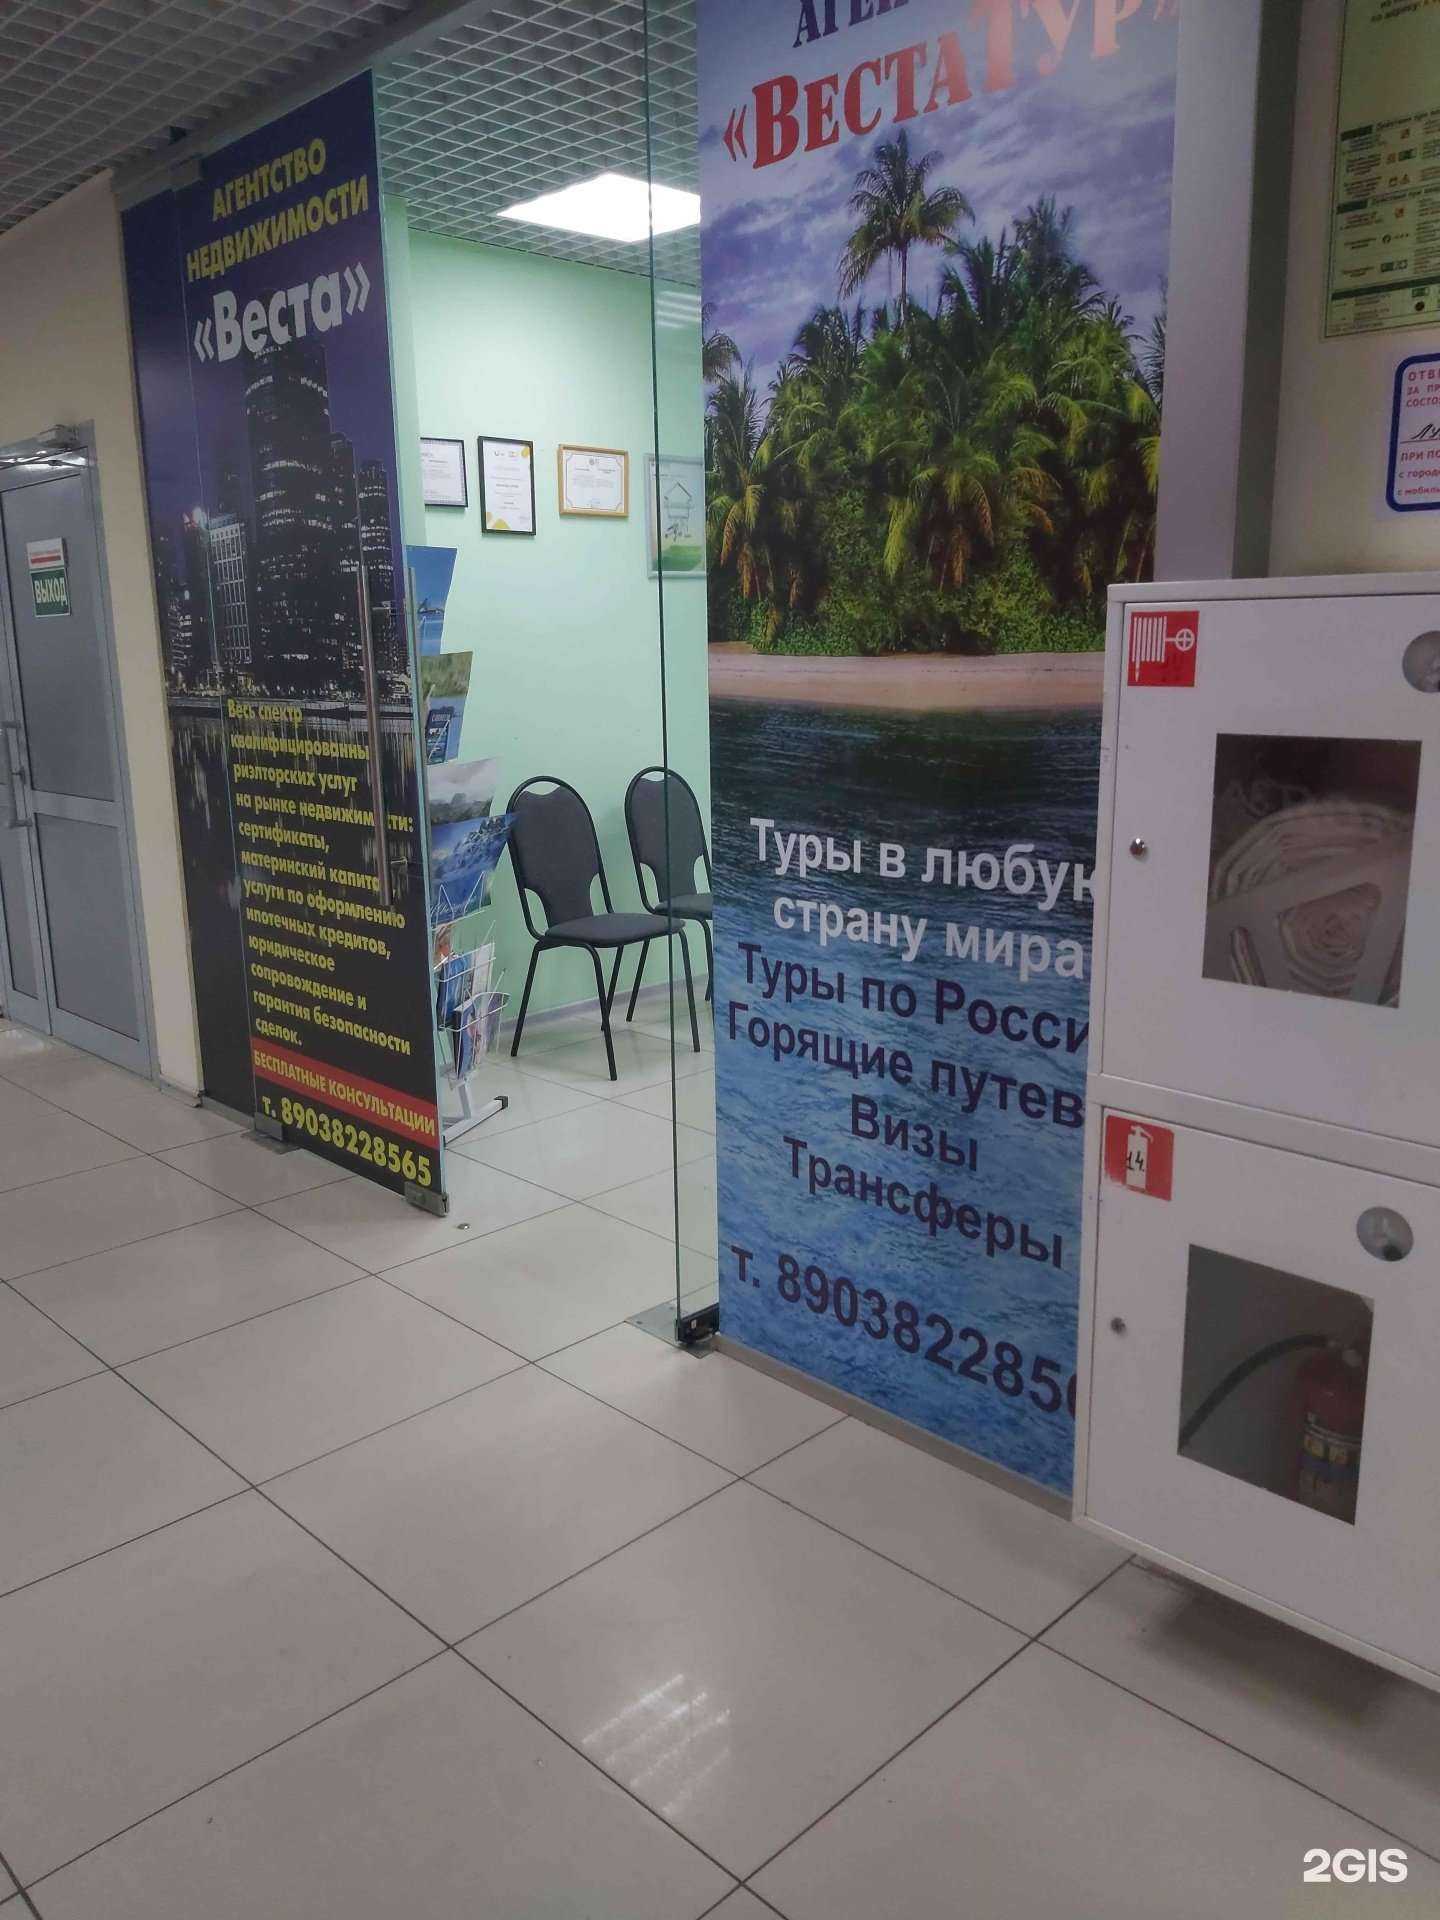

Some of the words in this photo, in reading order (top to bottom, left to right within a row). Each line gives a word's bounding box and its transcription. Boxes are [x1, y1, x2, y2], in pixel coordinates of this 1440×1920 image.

[212, 138, 326, 221] АГЕНТСТВО
[187, 174, 368, 282] НЕДВИЖИМОСТИ
[194, 262, 371, 363] «Веста»
[1408, 368, 1440, 382] ОТВ
[1406, 396, 1440, 408] СОСТО
[1401, 451, 1424, 462] ПРИ
[34, 577, 68, 607] ВЫХОД
[227, 699, 255, 718] Весь
[258, 704, 303, 729] спектр
[230, 731, 370, 761] квалифицированны
[233, 762, 316, 788] риэлторских
[318, 772, 358, 797] услуг
[236, 792, 252, 809] на
[255, 794, 297, 816] рынке
[299, 802, 415, 833] недвижимти:
[238, 821, 331, 854] сертификаты,
[240, 849, 327, 880] материнский
[750, 817, 861, 878] Туры
[879, 842, 907, 880] в
[243, 878, 286, 898] услуги
[287, 888, 304, 905] по
[306, 889, 407, 929] оформлению
[246, 906, 317, 938] ипотечных
[318, 924, 392, 961] кредитов,
[248, 935, 336, 972] юридическое
[773, 895, 928, 962] страну
[945, 921, 1085, 983] мира
[250, 962, 355, 1008] сопровождение
[357, 994, 368, 1011] и
[738, 942, 845, 1004] Туры
[861, 976, 918, 1019] по
[252, 989, 312, 1022] гарантия
[313, 1005, 412, 1057] безопасности
[255, 1016, 303, 1047] сделок.
[728, 1000, 914, 1086] Горящие
[253, 1049, 328, 1094] БЕСПЛАТНЫЕ
[328, 1079, 436, 1137] КОНСУЛЬТАЦИИ
[280, 1096, 432, 1187] 89038228565
[850, 1093, 980, 1172] Визы
[782, 1135, 1064, 1269] Трансферы
[776, 1252, 1077, 1419] 890382285
